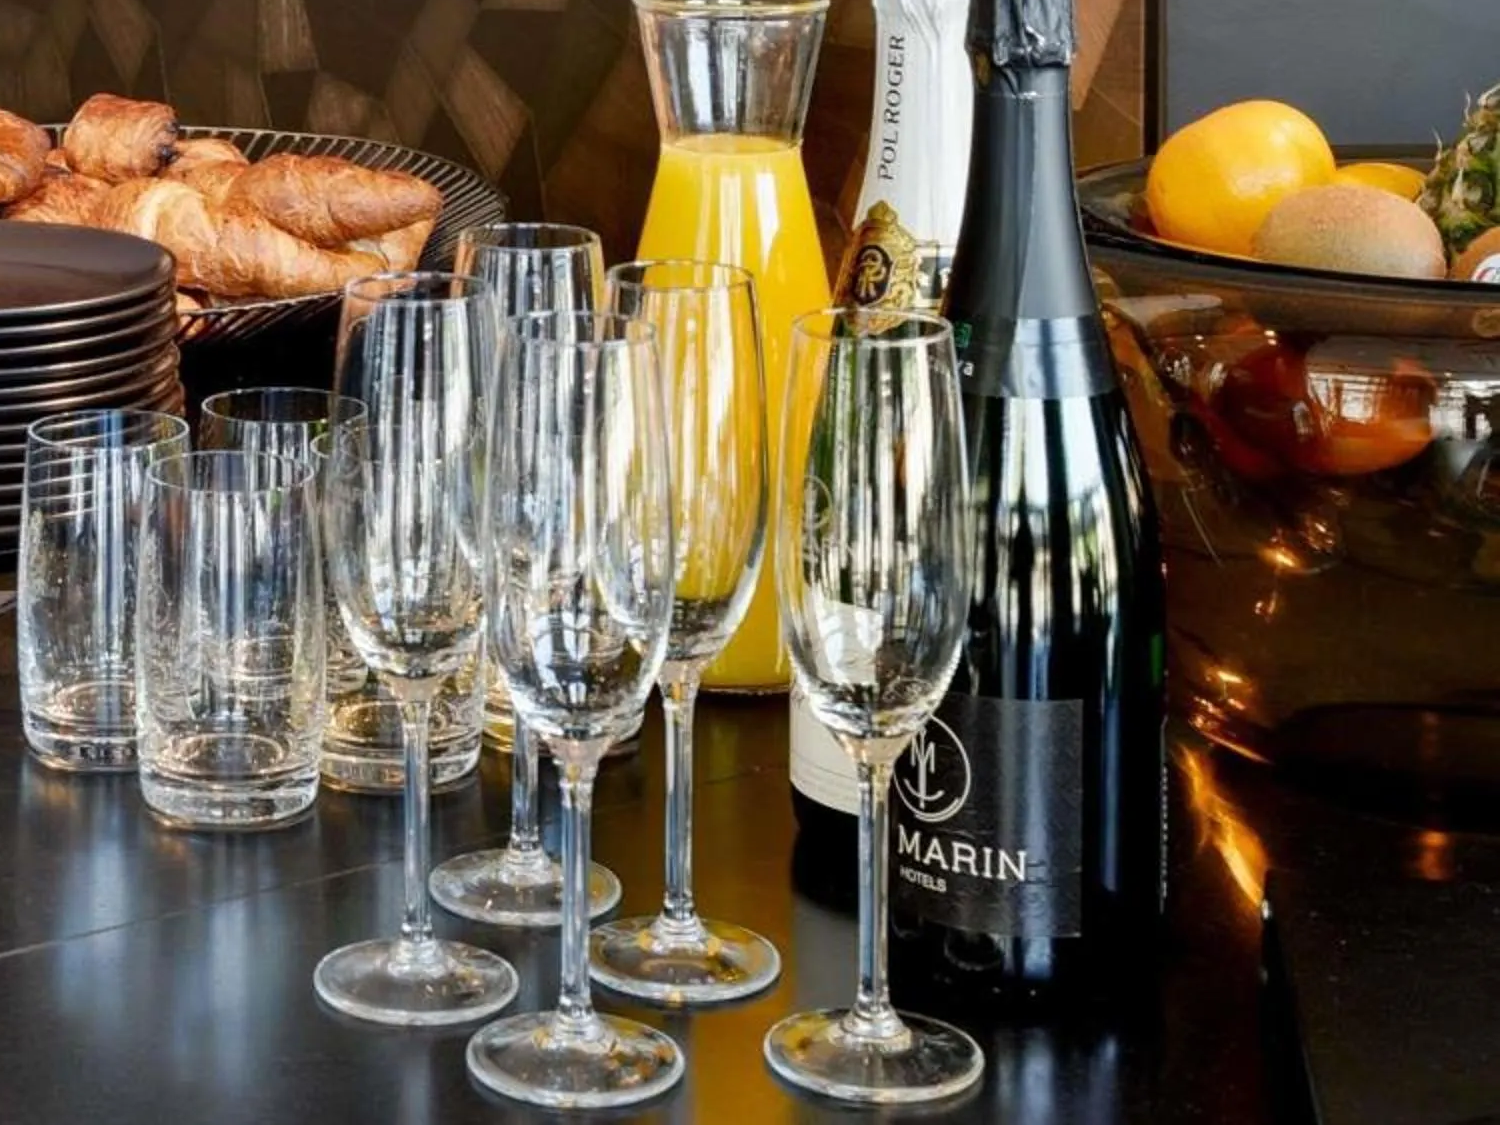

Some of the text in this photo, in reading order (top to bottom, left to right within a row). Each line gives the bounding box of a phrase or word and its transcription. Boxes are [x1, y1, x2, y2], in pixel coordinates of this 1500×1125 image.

[877, 35, 905, 180] POL ROGER
[898, 823, 1027, 882] MARIN
[900, 865, 947, 893] HOTELS
